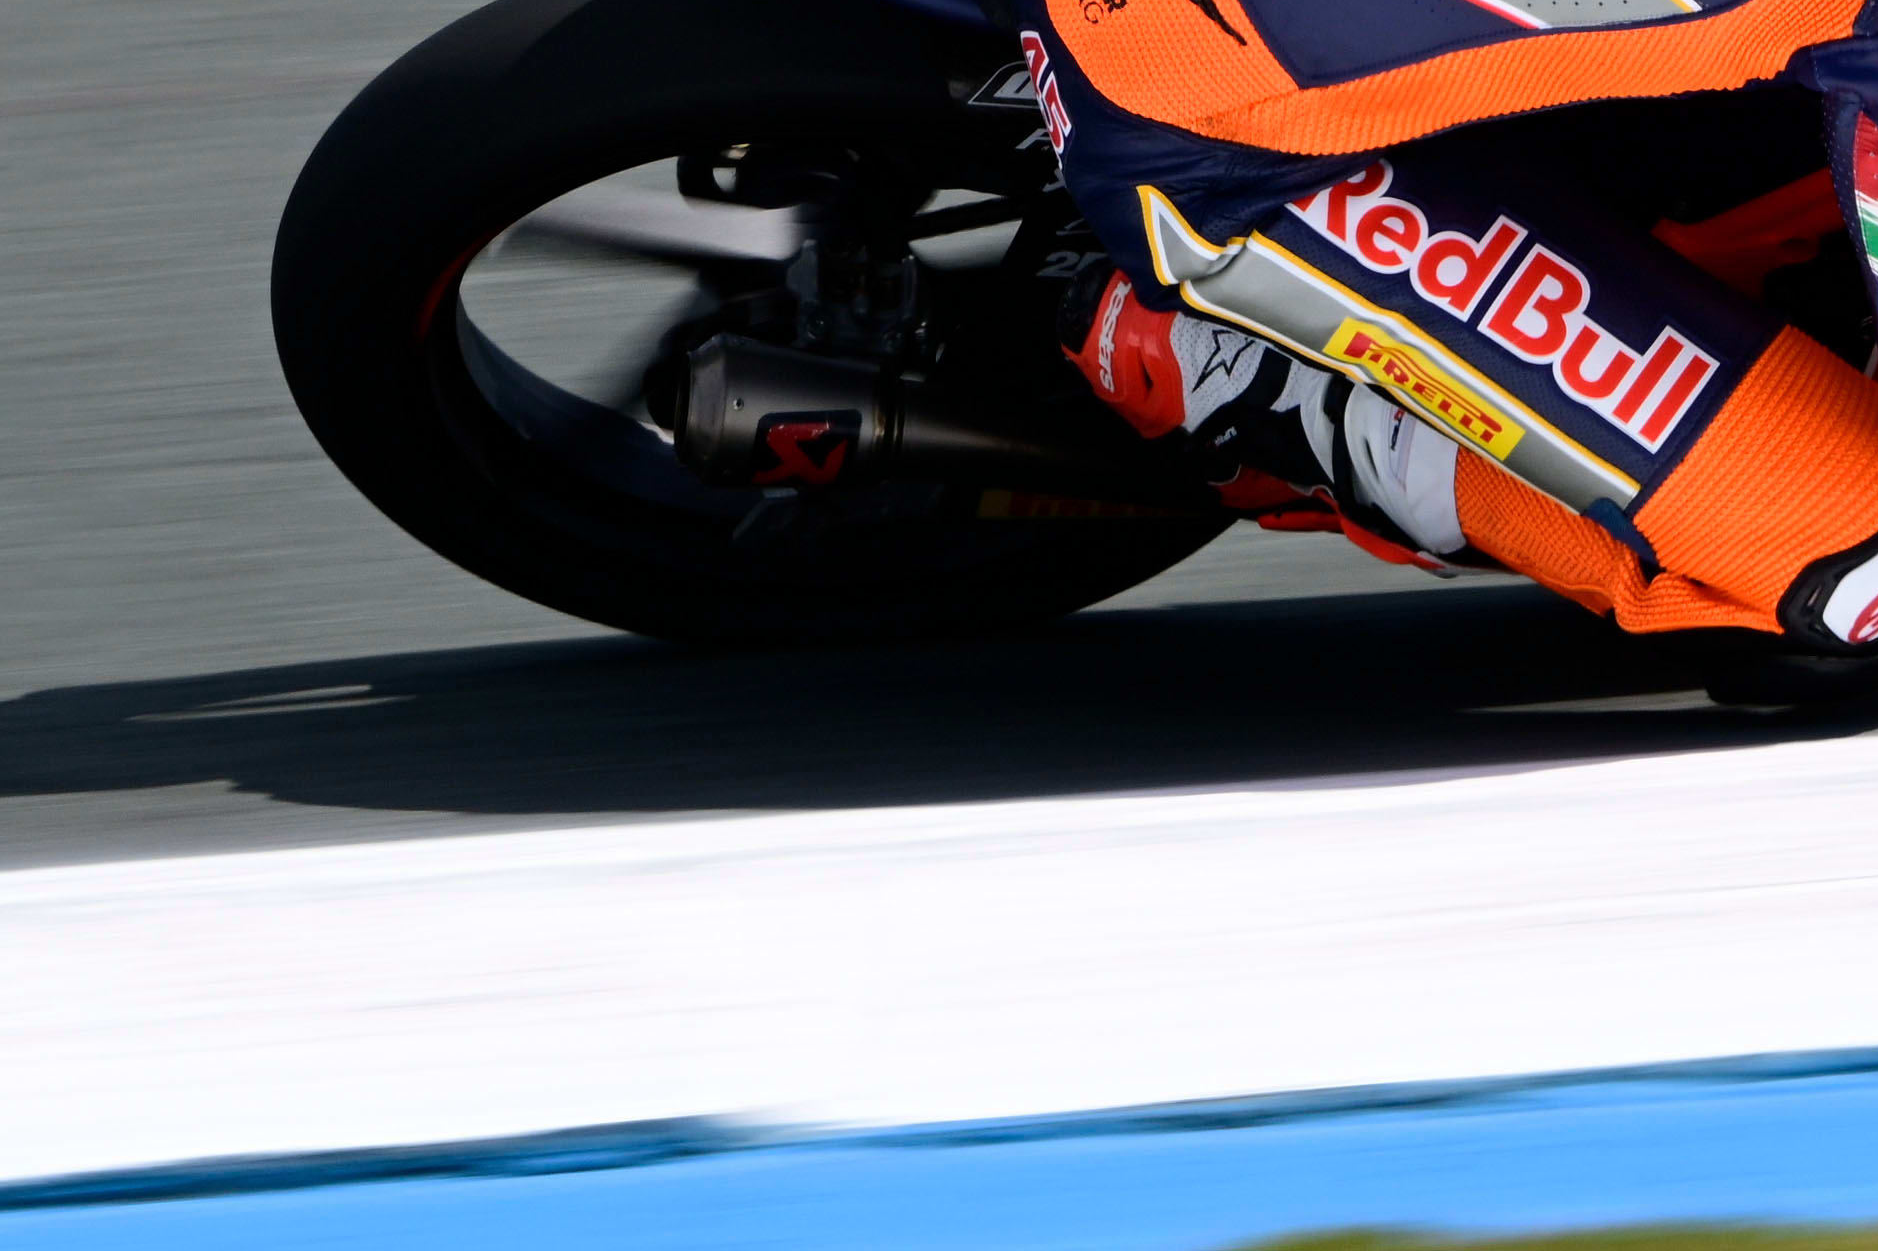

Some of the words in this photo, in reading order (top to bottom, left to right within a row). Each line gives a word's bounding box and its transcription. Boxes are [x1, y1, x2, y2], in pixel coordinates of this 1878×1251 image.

[1287, 158, 1529, 321] Red
[1477, 243, 1721, 455] Bull
[1343, 330, 1503, 445] PIRELLI
